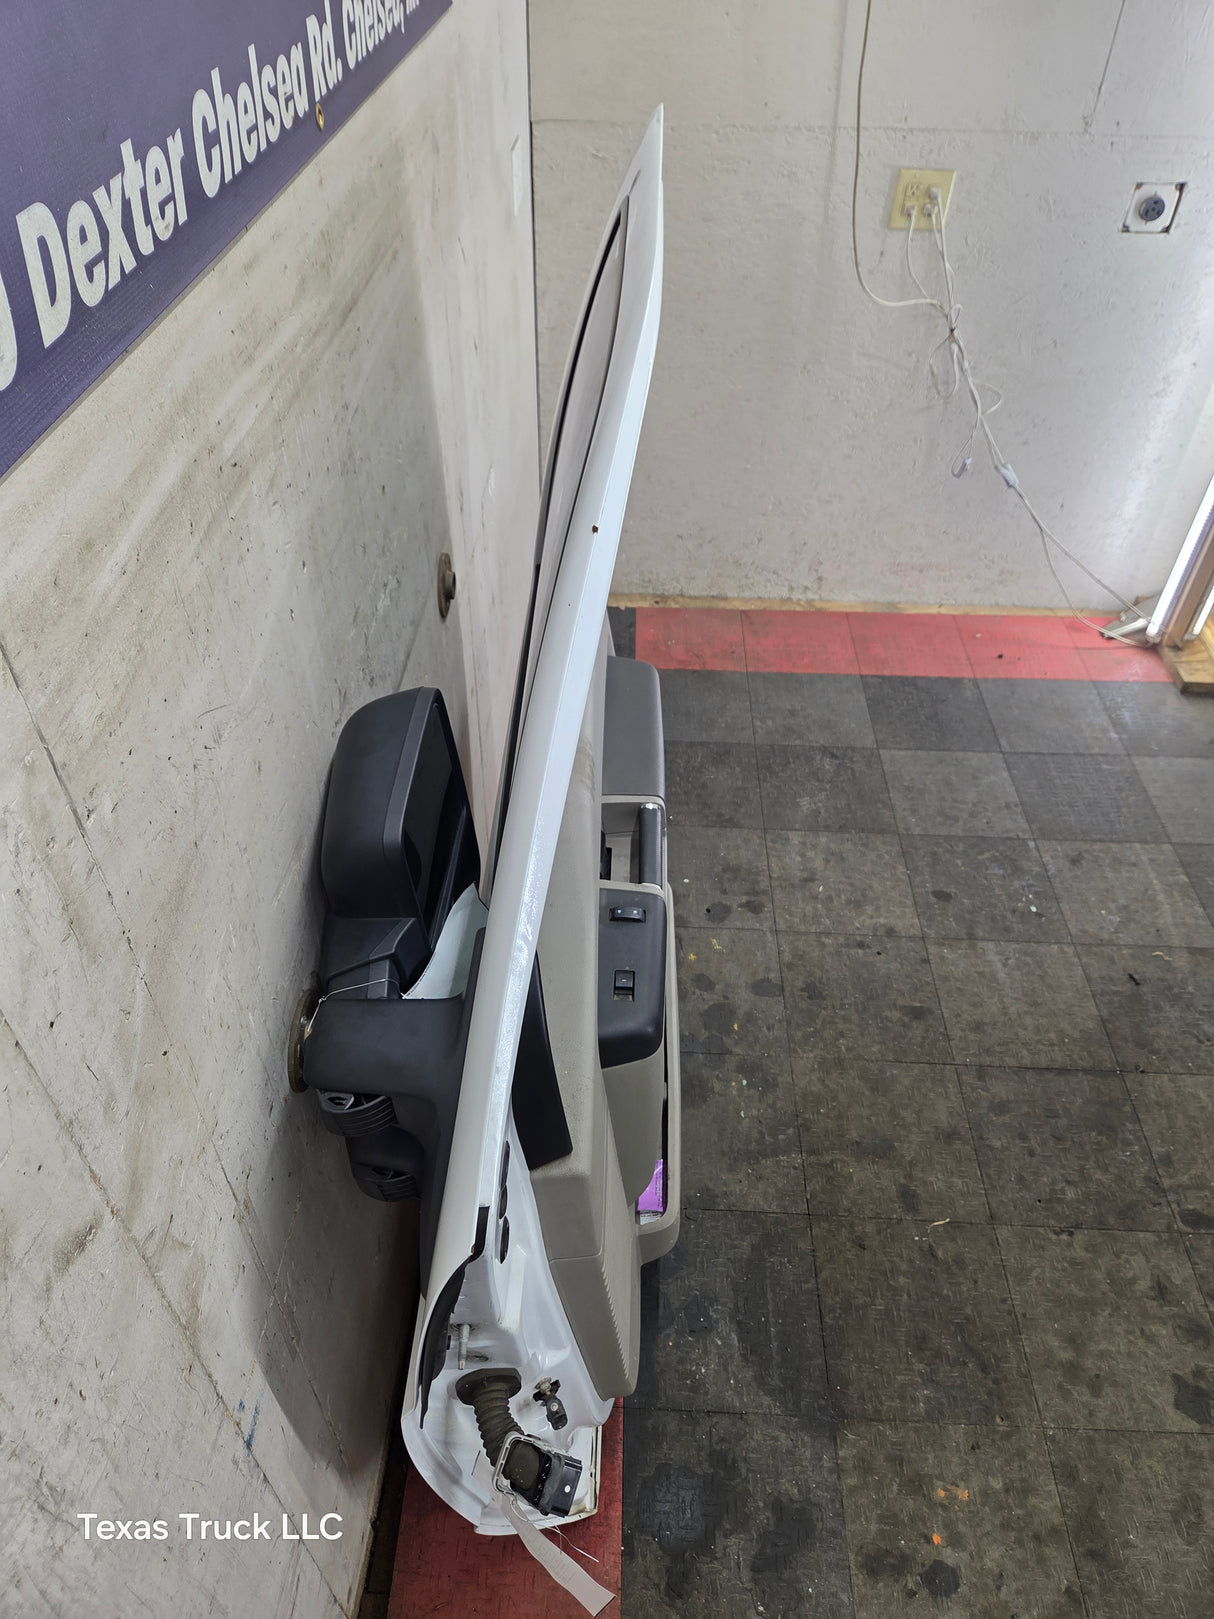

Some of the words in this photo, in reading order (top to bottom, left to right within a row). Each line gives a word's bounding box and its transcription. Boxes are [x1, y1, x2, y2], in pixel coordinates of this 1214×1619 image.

[16, 127, 188, 349] Dexter
[192, 43, 309, 198] Chelsea
[306, 0, 343, 103] Rd.
